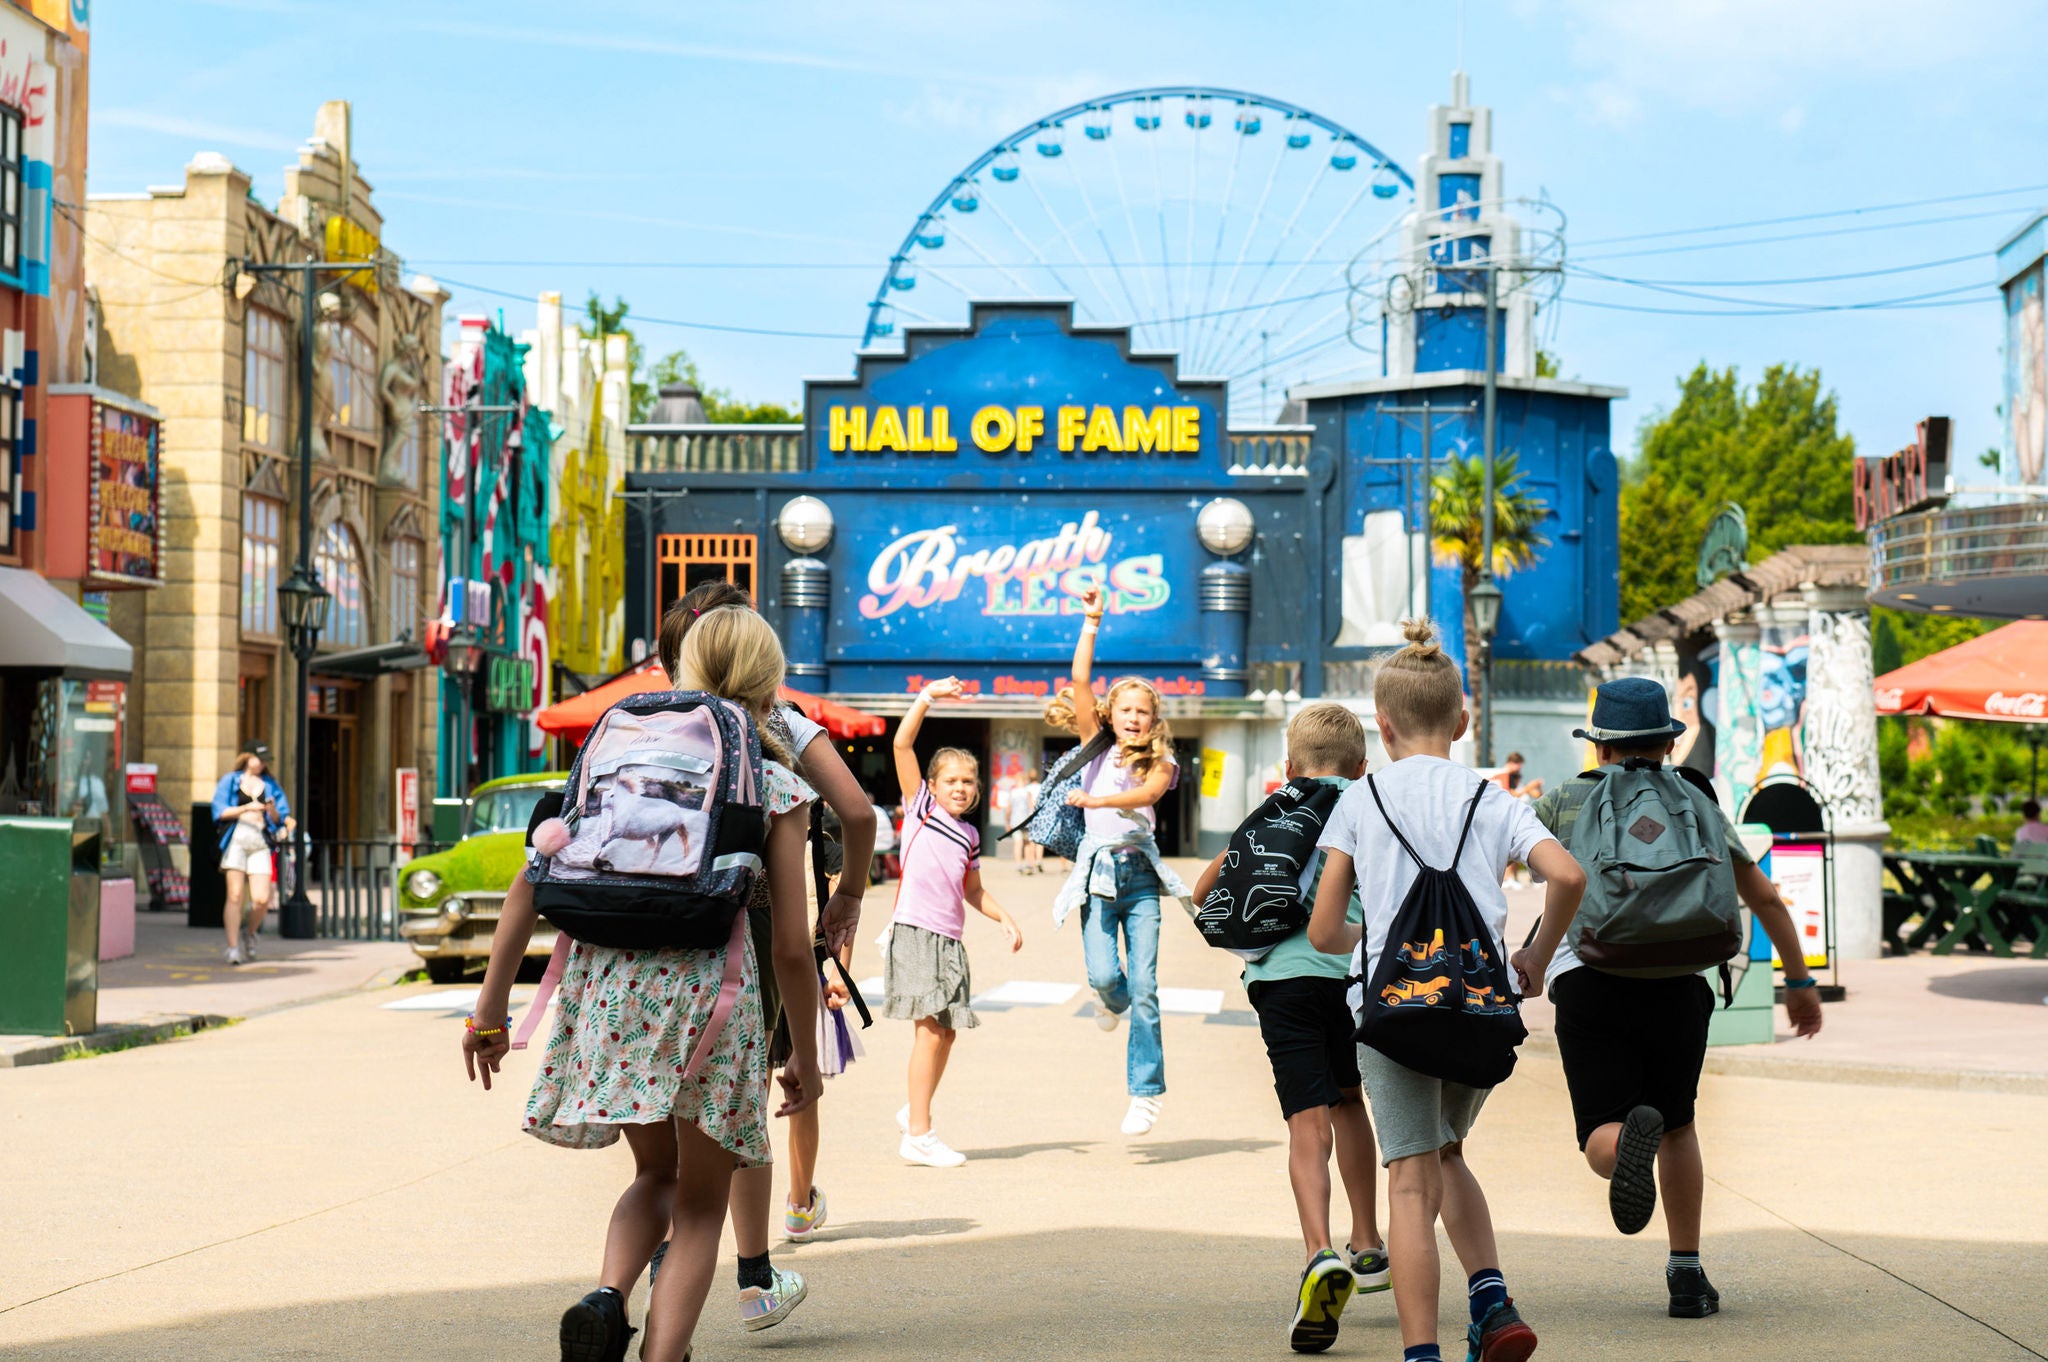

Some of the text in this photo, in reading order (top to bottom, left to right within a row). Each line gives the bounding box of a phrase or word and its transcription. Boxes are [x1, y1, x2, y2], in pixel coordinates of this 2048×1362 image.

[829, 406, 1200, 453] HALL OF FAME
[859, 510, 1112, 619] Breath
[981, 554, 1170, 616] LESS
[490, 655, 533, 710] OPEN
[993, 675, 1049, 697] Shop
